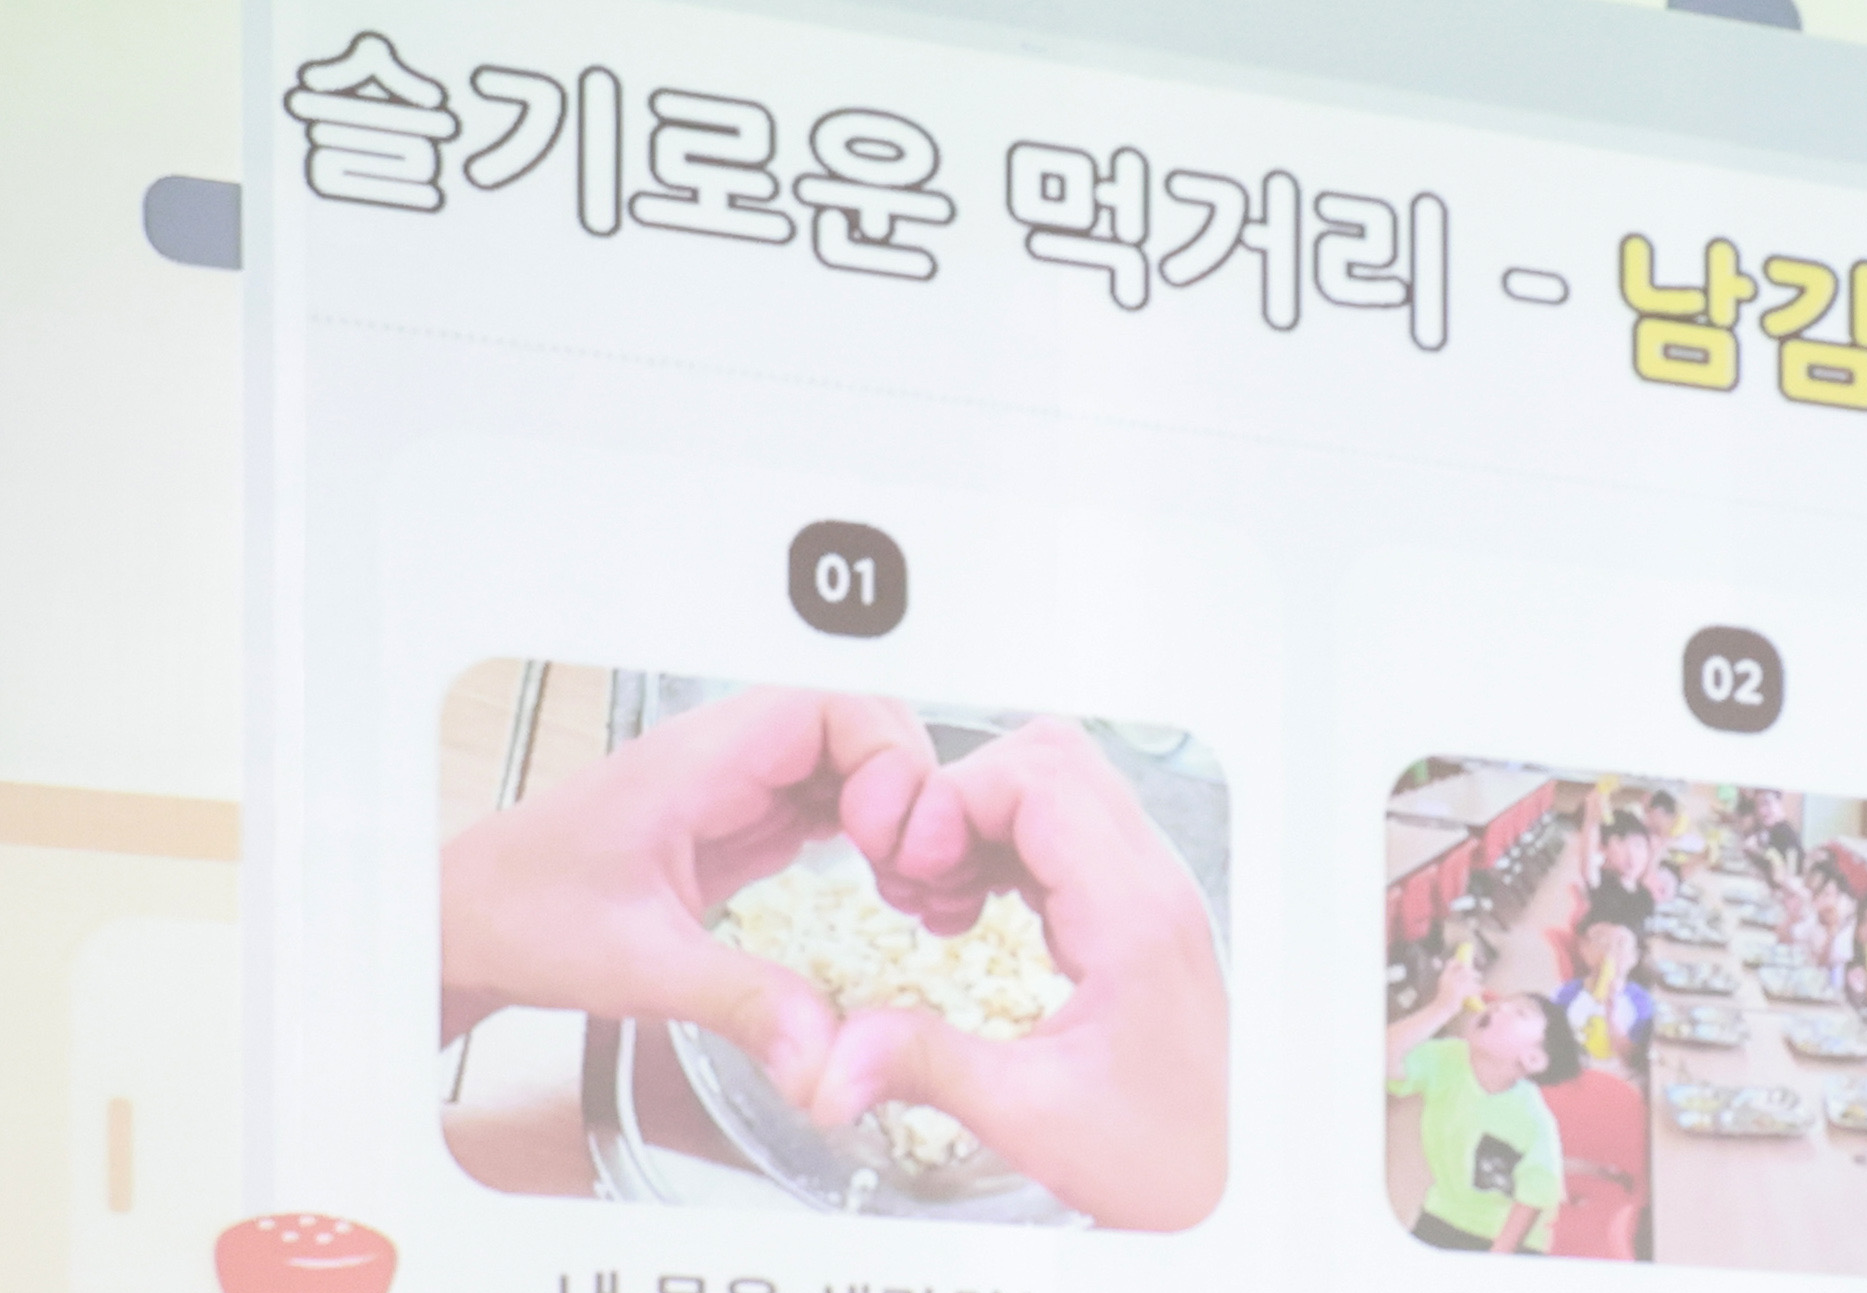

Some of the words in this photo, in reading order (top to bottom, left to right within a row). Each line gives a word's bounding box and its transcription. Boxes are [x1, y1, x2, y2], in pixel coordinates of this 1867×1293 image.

[282, 29, 958, 282] 슬기로운
[1004, 139, 1450, 353] 먹거리
[1500, 266, 1571, 307] -
[816, 553, 875, 605] 01
[1701, 655, 1763, 705] 02
